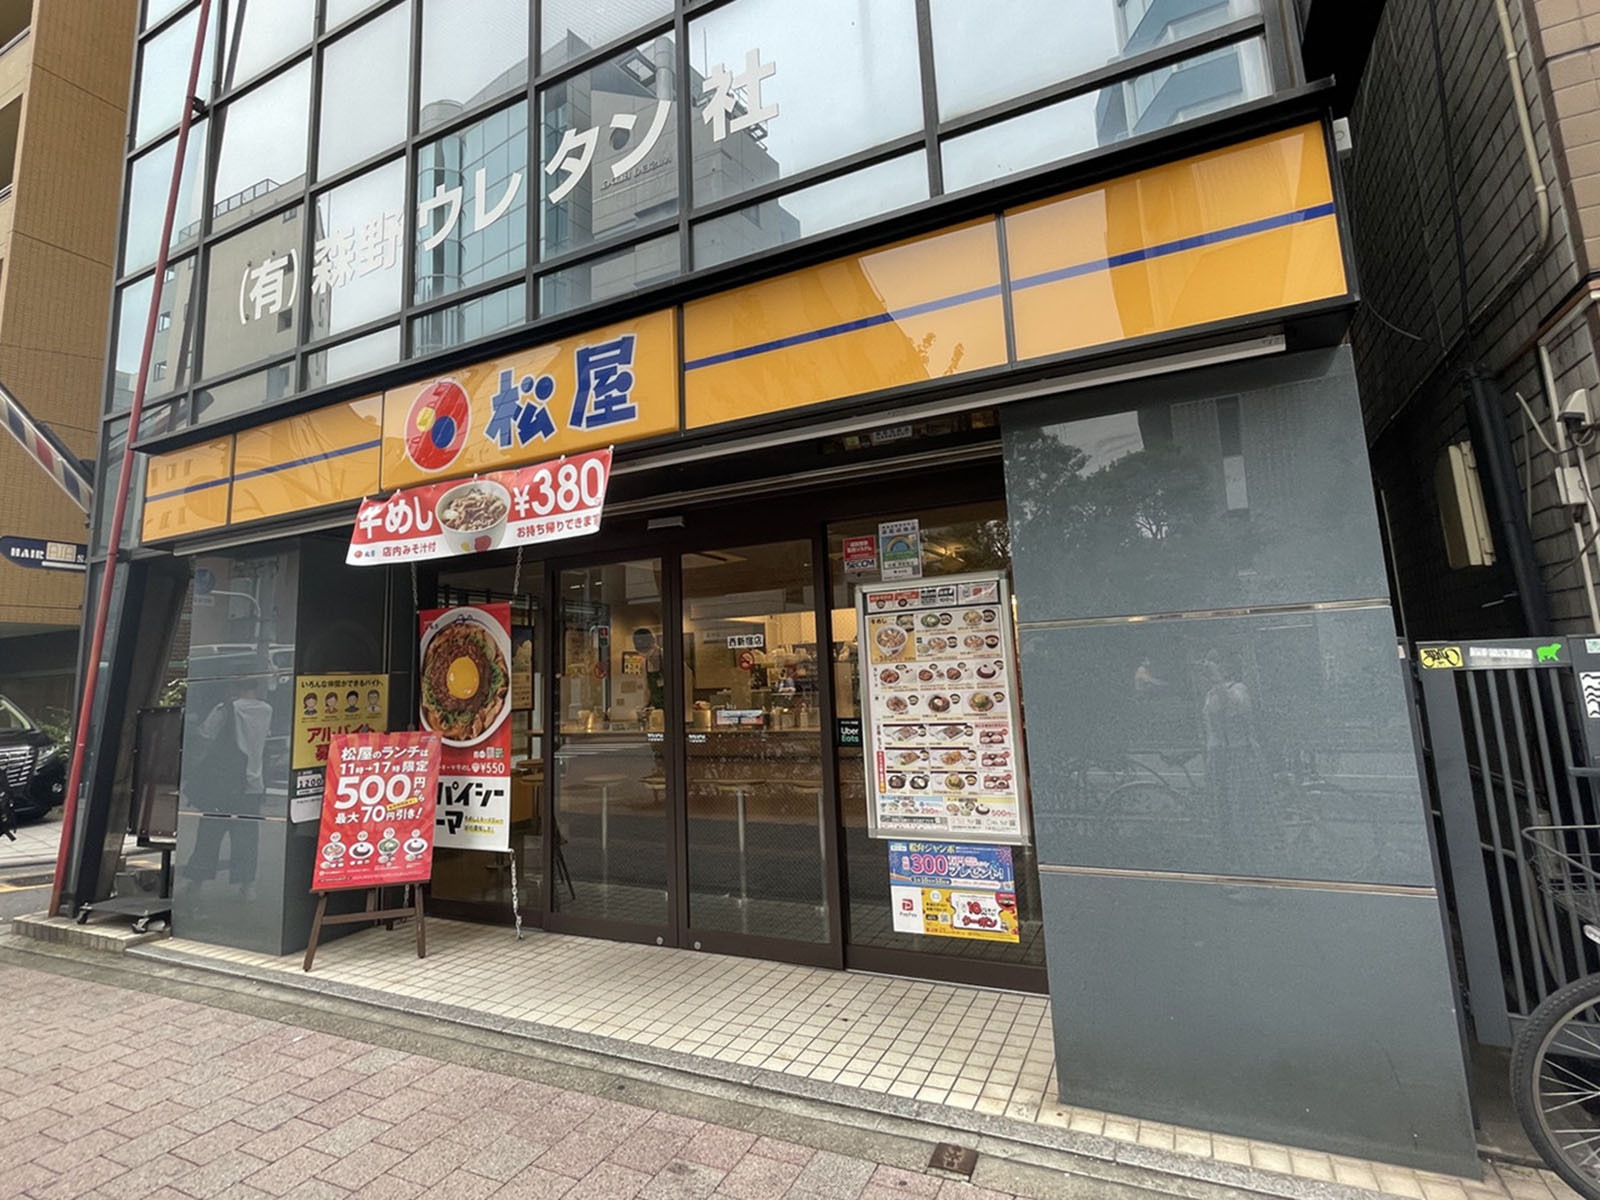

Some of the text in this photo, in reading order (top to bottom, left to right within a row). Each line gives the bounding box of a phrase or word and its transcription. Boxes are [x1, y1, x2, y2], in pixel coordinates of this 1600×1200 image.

[484, 333, 637, 449] 松屋
[10, 547, 44, 559] HAIR
[382, 542, 437, 557] 店内みそ汁付
[729, 636, 762, 647] 西新宿店
[840, 727, 860, 735] Uber
[841, 734, 860, 742] Eats
[341, 745, 429, 761] 松屋のランチは
